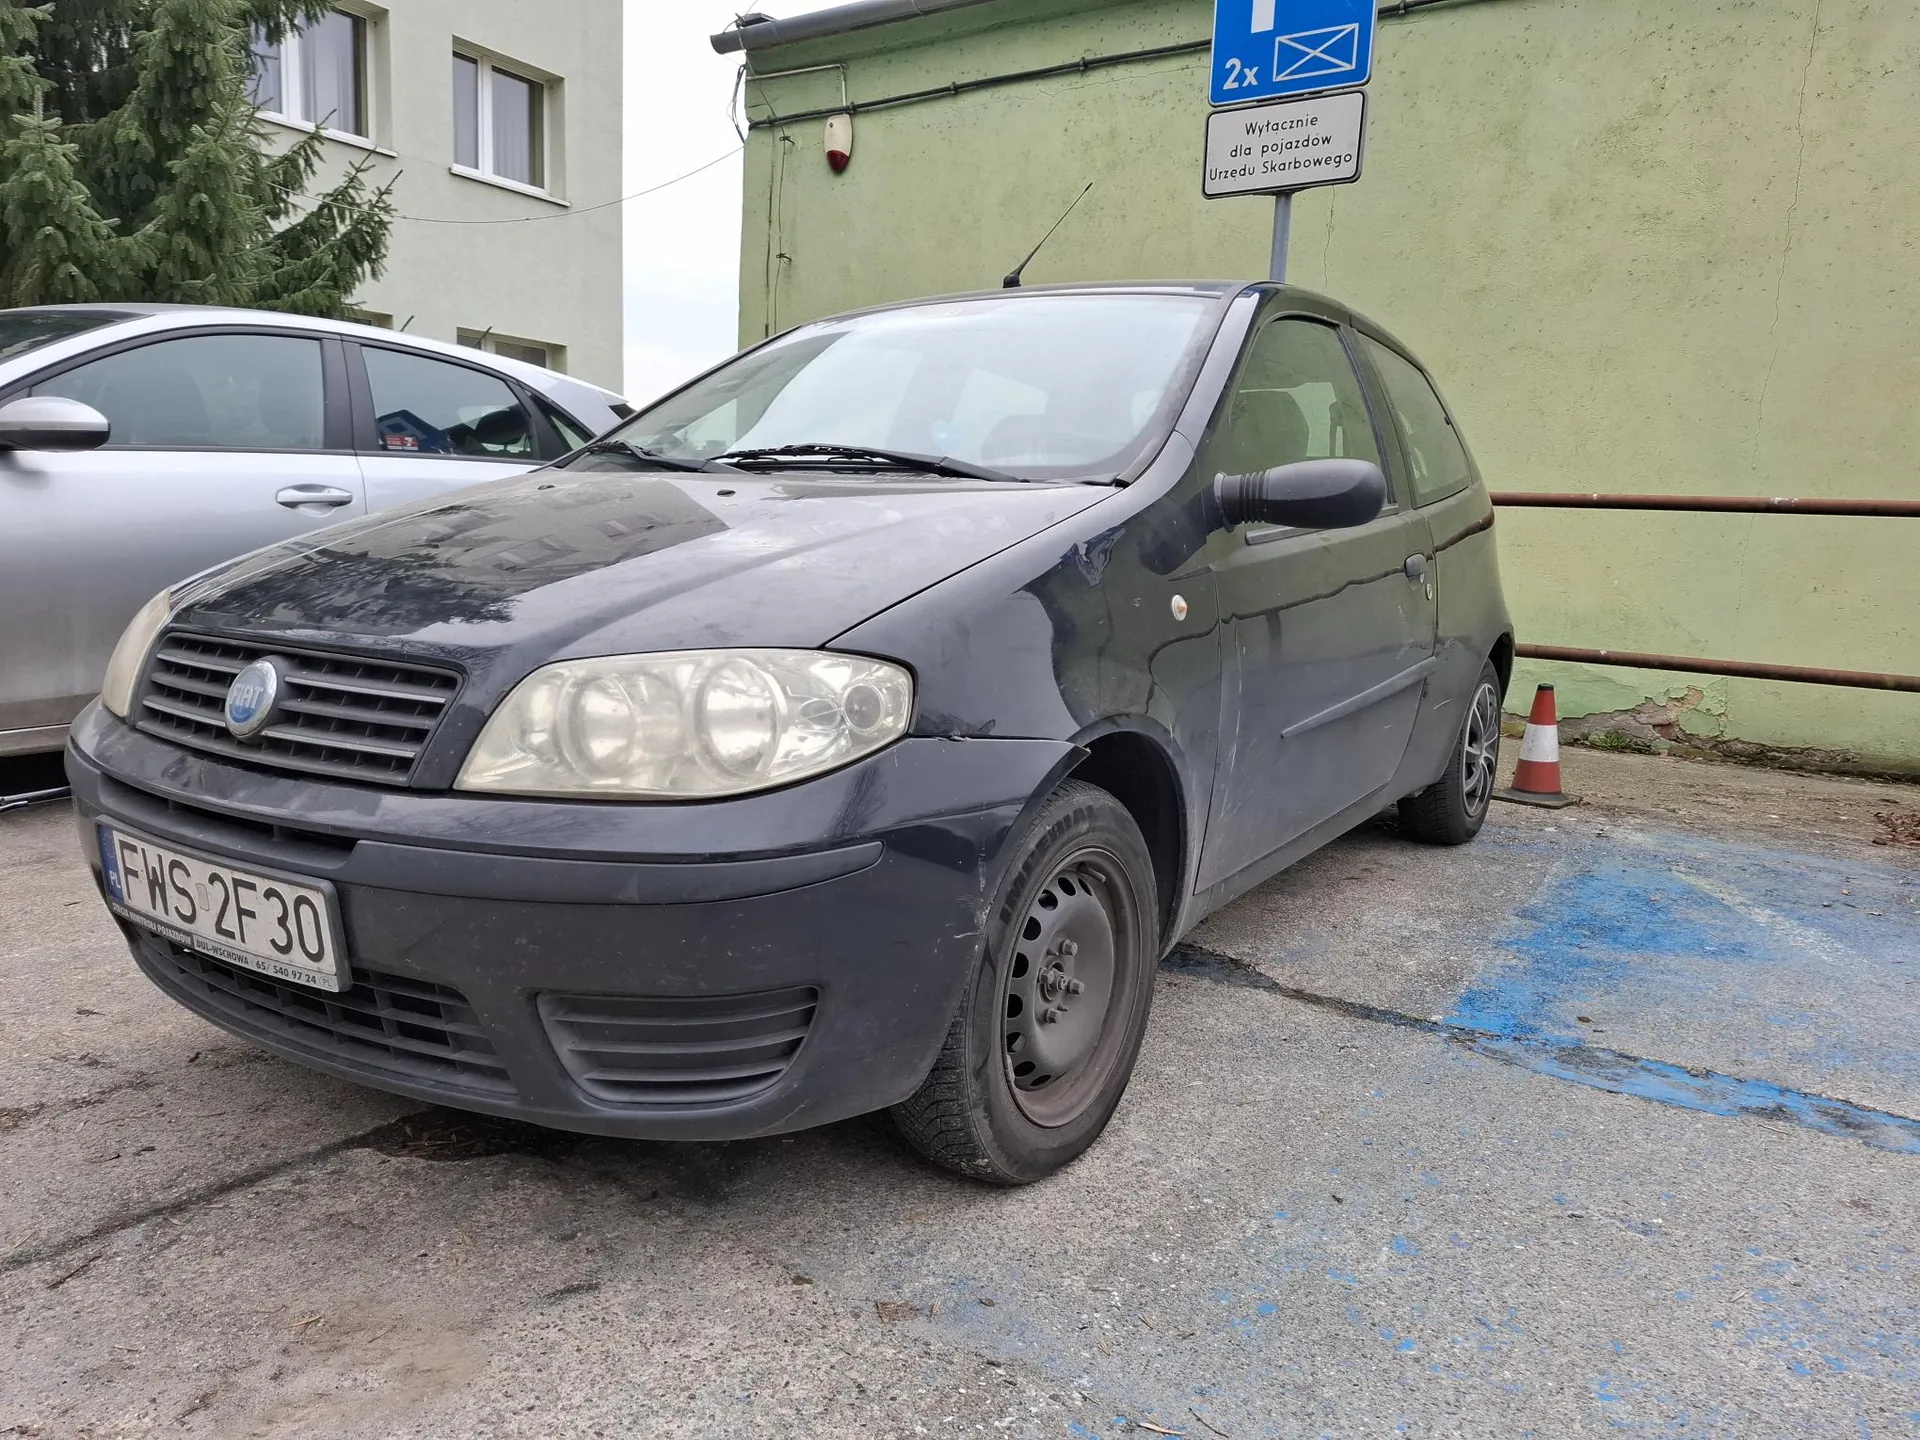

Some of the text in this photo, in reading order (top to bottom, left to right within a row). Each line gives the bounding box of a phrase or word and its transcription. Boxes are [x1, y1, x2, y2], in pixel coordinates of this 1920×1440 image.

[1222, 57, 1259, 90] 2x
[1244, 114, 1319, 138] Wyłącznie
[1229, 133, 1333, 158] dla pojazdów
[1209, 152, 1353, 182] Urzędu Skarbowego
[109, 870, 121, 889] PL
[118, 838, 326, 963] FWS 2F30
[272, 965, 289, 977] 540
[291, 970, 302, 981] 97
[304, 974, 317, 984] 24
